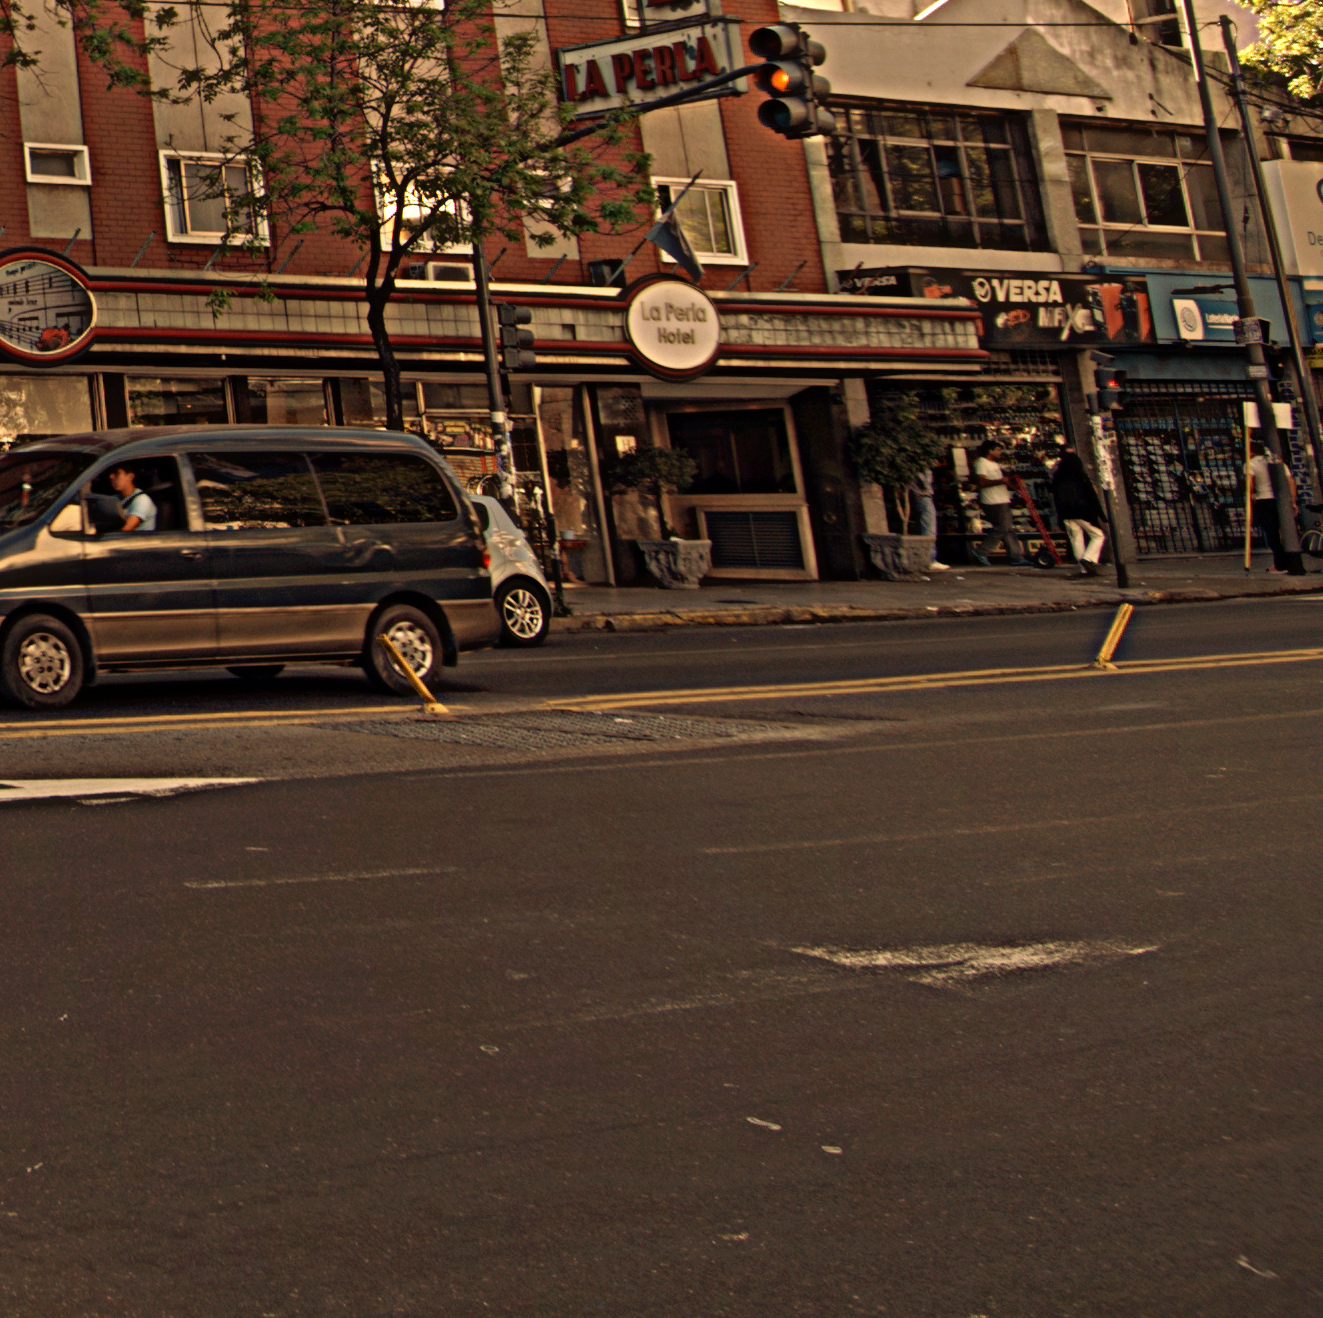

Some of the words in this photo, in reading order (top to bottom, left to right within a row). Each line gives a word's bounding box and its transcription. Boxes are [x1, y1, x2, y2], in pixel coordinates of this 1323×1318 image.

[565, 58, 608, 102] LA
[612, 36, 721, 94] PERLA
[991, 279, 1063, 303] VERSA
[640, 301, 661, 321] La
[665, 302, 707, 322] Perla
[657, 327, 695, 344] Hotel
